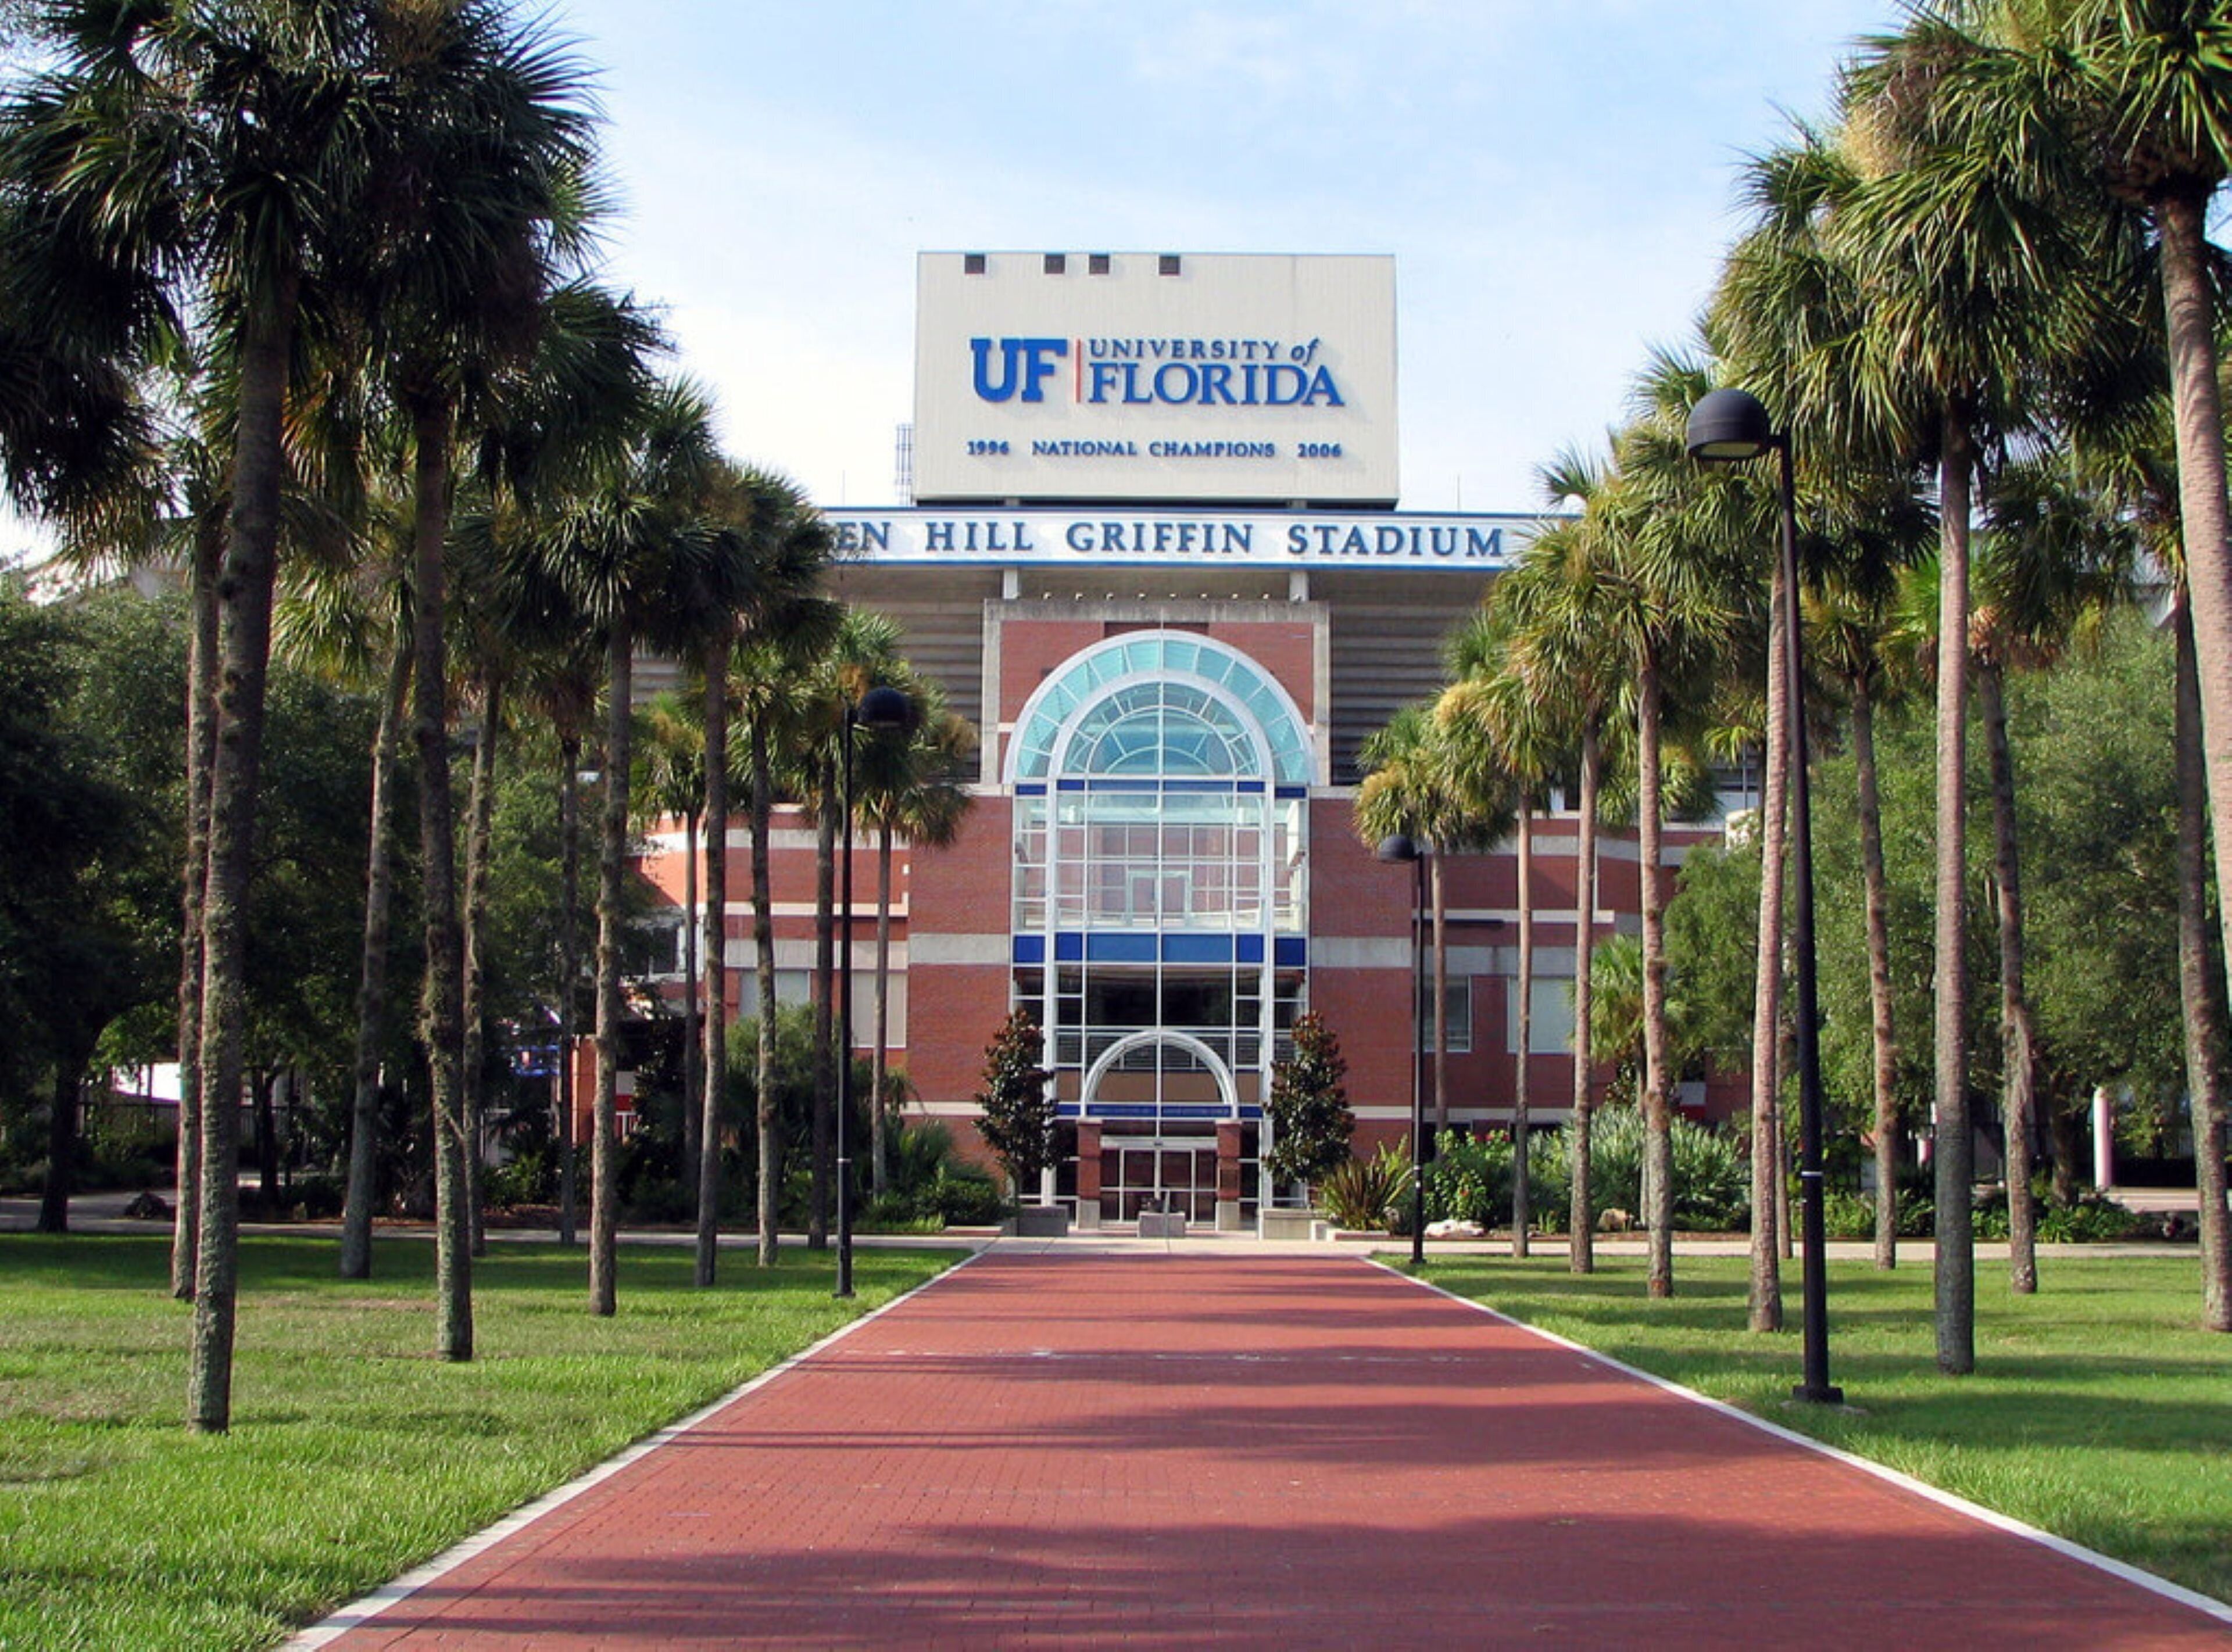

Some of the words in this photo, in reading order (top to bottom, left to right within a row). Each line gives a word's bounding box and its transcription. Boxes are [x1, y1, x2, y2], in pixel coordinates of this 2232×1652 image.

[1089, 339, 1279, 358] UNIVERSITY
[1290, 336, 1320, 367] of
[970, 338, 1068, 402] UF
[1088, 362, 1345, 406] FLORIDA
[967, 440, 1010, 456] 1996
[1032, 440, 1138, 456] NATIONAL
[1149, 440, 1276, 458] CHAMPIONS
[1298, 443, 1343, 458] 2006
[824, 522, 891, 551] EN
[925, 522, 1033, 551] HILL
[1065, 522, 1253, 553] GRIFFIN
[1287, 524, 1503, 557] STADIUM
